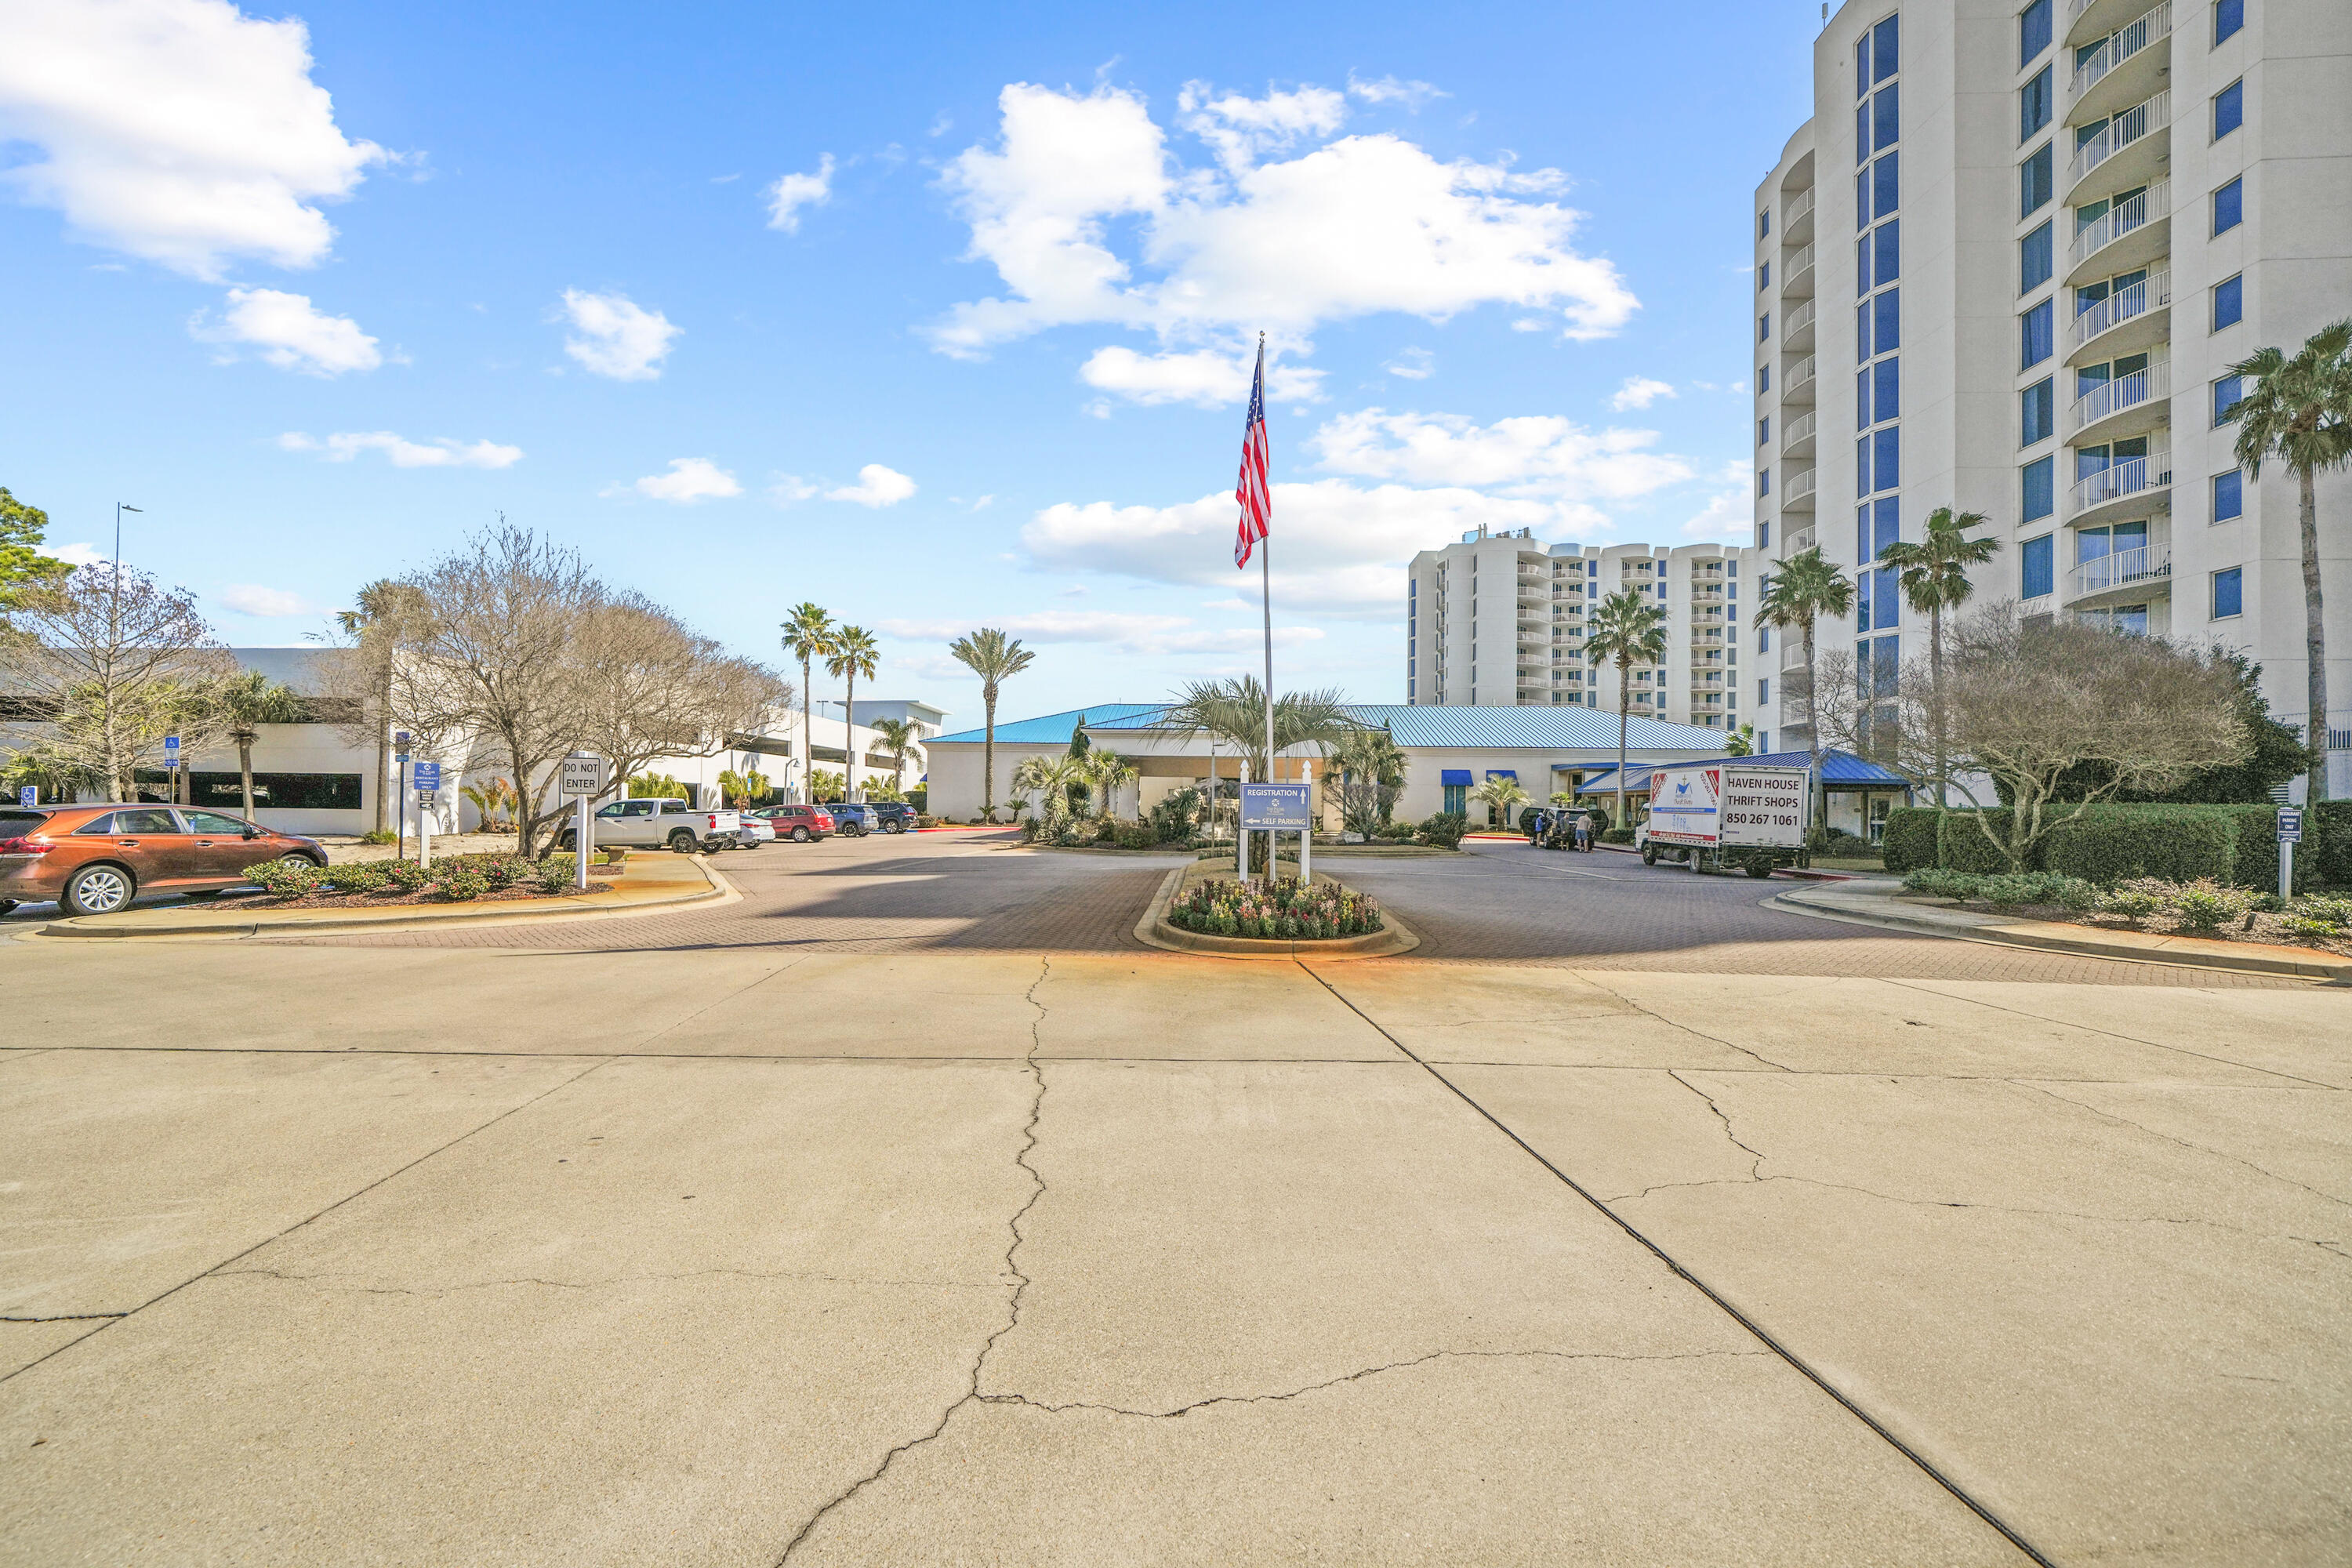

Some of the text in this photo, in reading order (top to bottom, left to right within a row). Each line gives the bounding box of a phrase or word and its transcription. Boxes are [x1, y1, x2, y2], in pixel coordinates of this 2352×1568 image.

[564, 763, 597, 772] DO NOT
[566, 779, 595, 788] ENTER
[1728, 778, 1762, 789] HAVEN
[1764, 779, 1799, 790] HOUSE
[1727, 796, 1798, 808] THRIFT SHOPS
[1726, 812, 1798, 826] 850 267 1061
